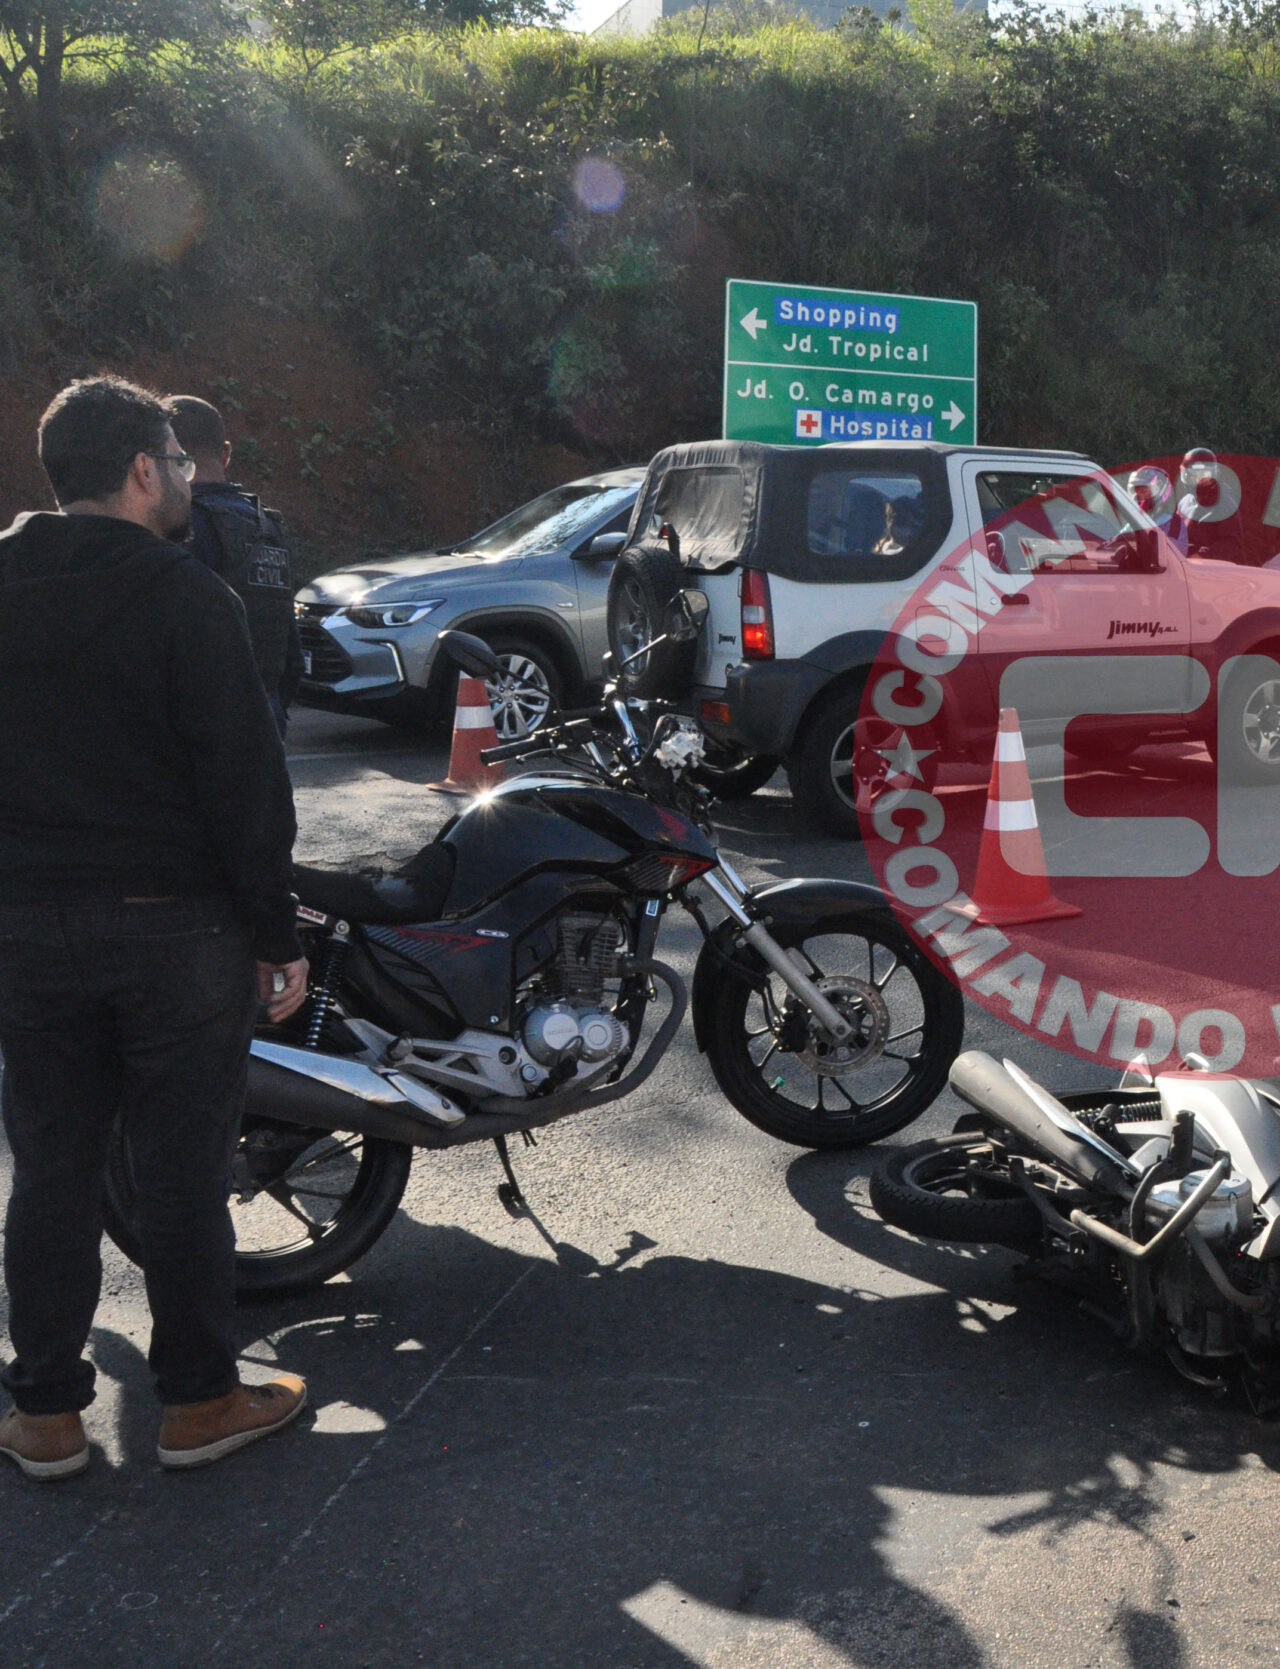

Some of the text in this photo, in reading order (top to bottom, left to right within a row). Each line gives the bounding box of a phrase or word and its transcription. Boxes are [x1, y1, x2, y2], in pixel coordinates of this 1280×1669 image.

[779, 299, 897, 334] Shopping
[782, 333, 928, 362] Jd. Tropical
[737, 378, 935, 413] Jd. O. Camargo
[829, 415, 933, 440] Hospital
[1106, 620, 1161, 640] Jimny
